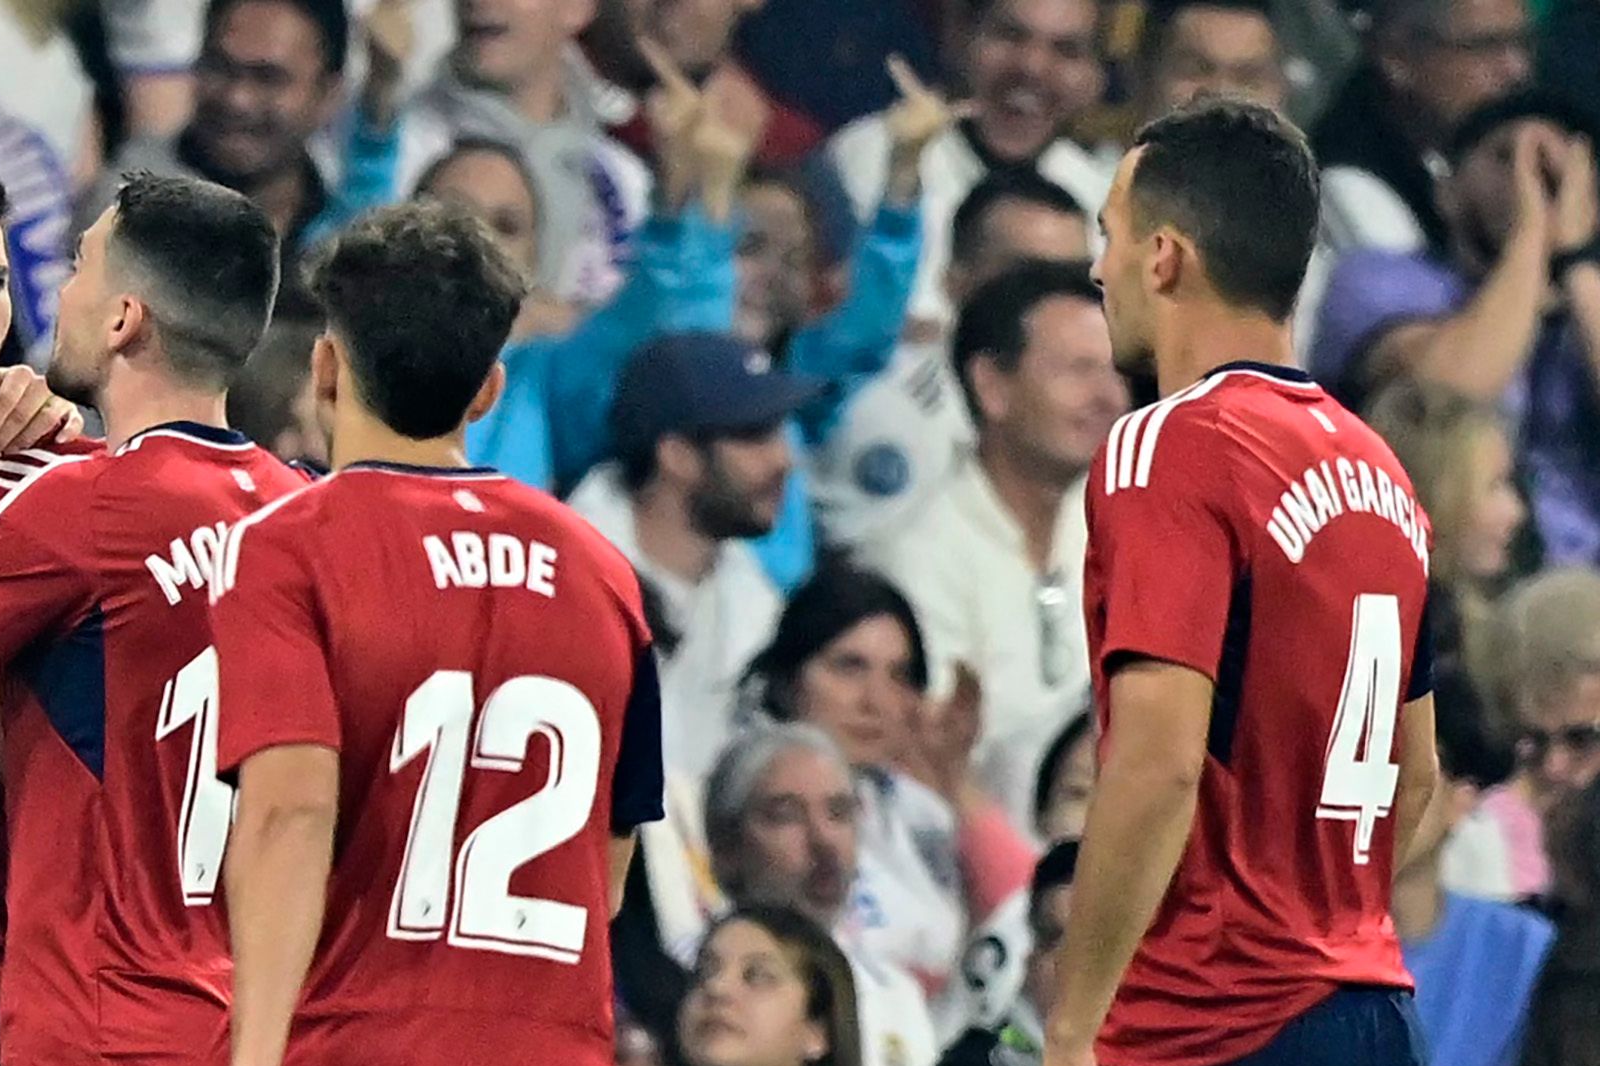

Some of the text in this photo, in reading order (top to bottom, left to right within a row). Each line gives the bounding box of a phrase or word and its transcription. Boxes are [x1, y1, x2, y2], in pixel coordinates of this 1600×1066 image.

[422, 530, 558, 598] ABDE
[1267, 460, 1343, 564] UNAI
[155, 644, 238, 907] 1
[385, 668, 602, 963] 12
[1315, 592, 1400, 865] 4
